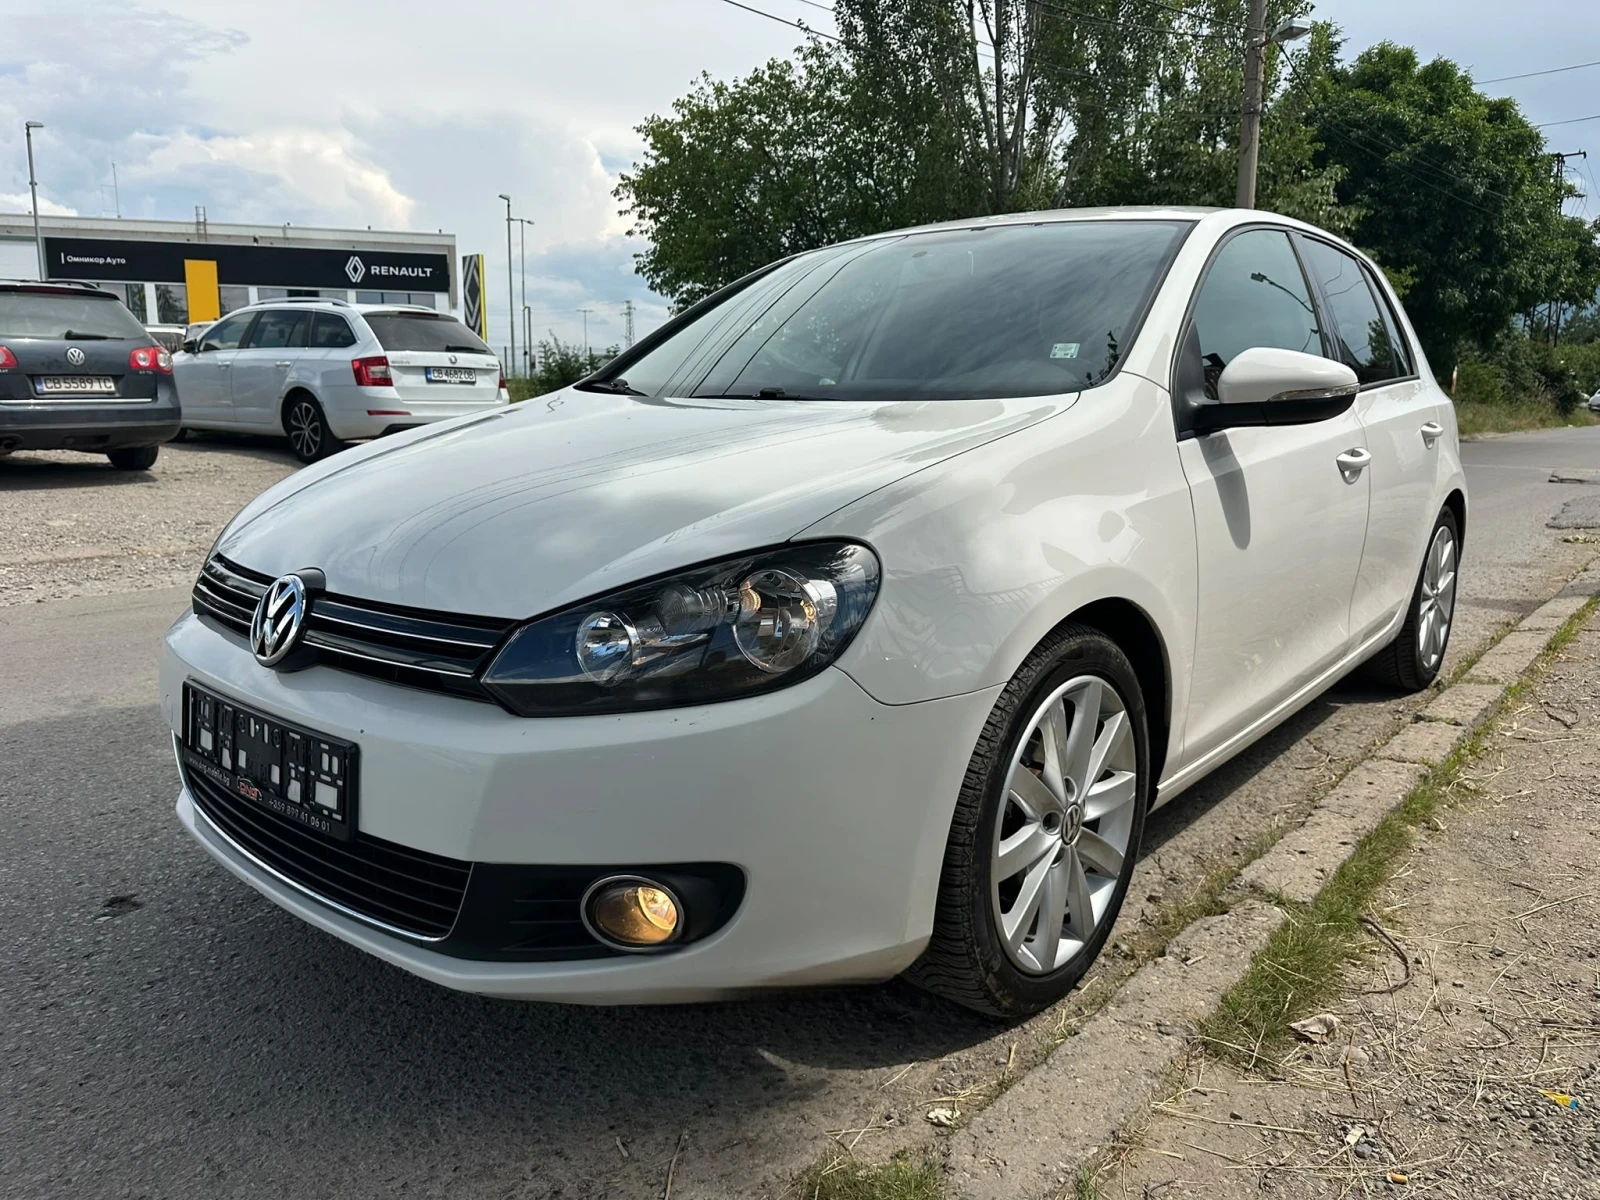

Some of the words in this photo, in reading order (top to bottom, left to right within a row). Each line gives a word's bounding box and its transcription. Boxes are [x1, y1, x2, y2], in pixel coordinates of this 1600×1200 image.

[66, 255, 105, 264] Омникор
[106, 256, 126, 265] Ауто
[370, 265, 433, 277] RENAULT
[432, 368, 443, 378] CB
[445, 369, 463, 380] 4682
[44, 377, 62, 389] CB
[64, 377, 93, 389] 5589
[96, 377, 112, 389] TC
[239, 782, 258, 799] DNG
[269, 798, 285, 812] +359
[286, 805, 299, 818] 899
[300, 811, 308, 823] 41
[310, 816, 319, 828] 06
[321, 821, 330, 832] 01
